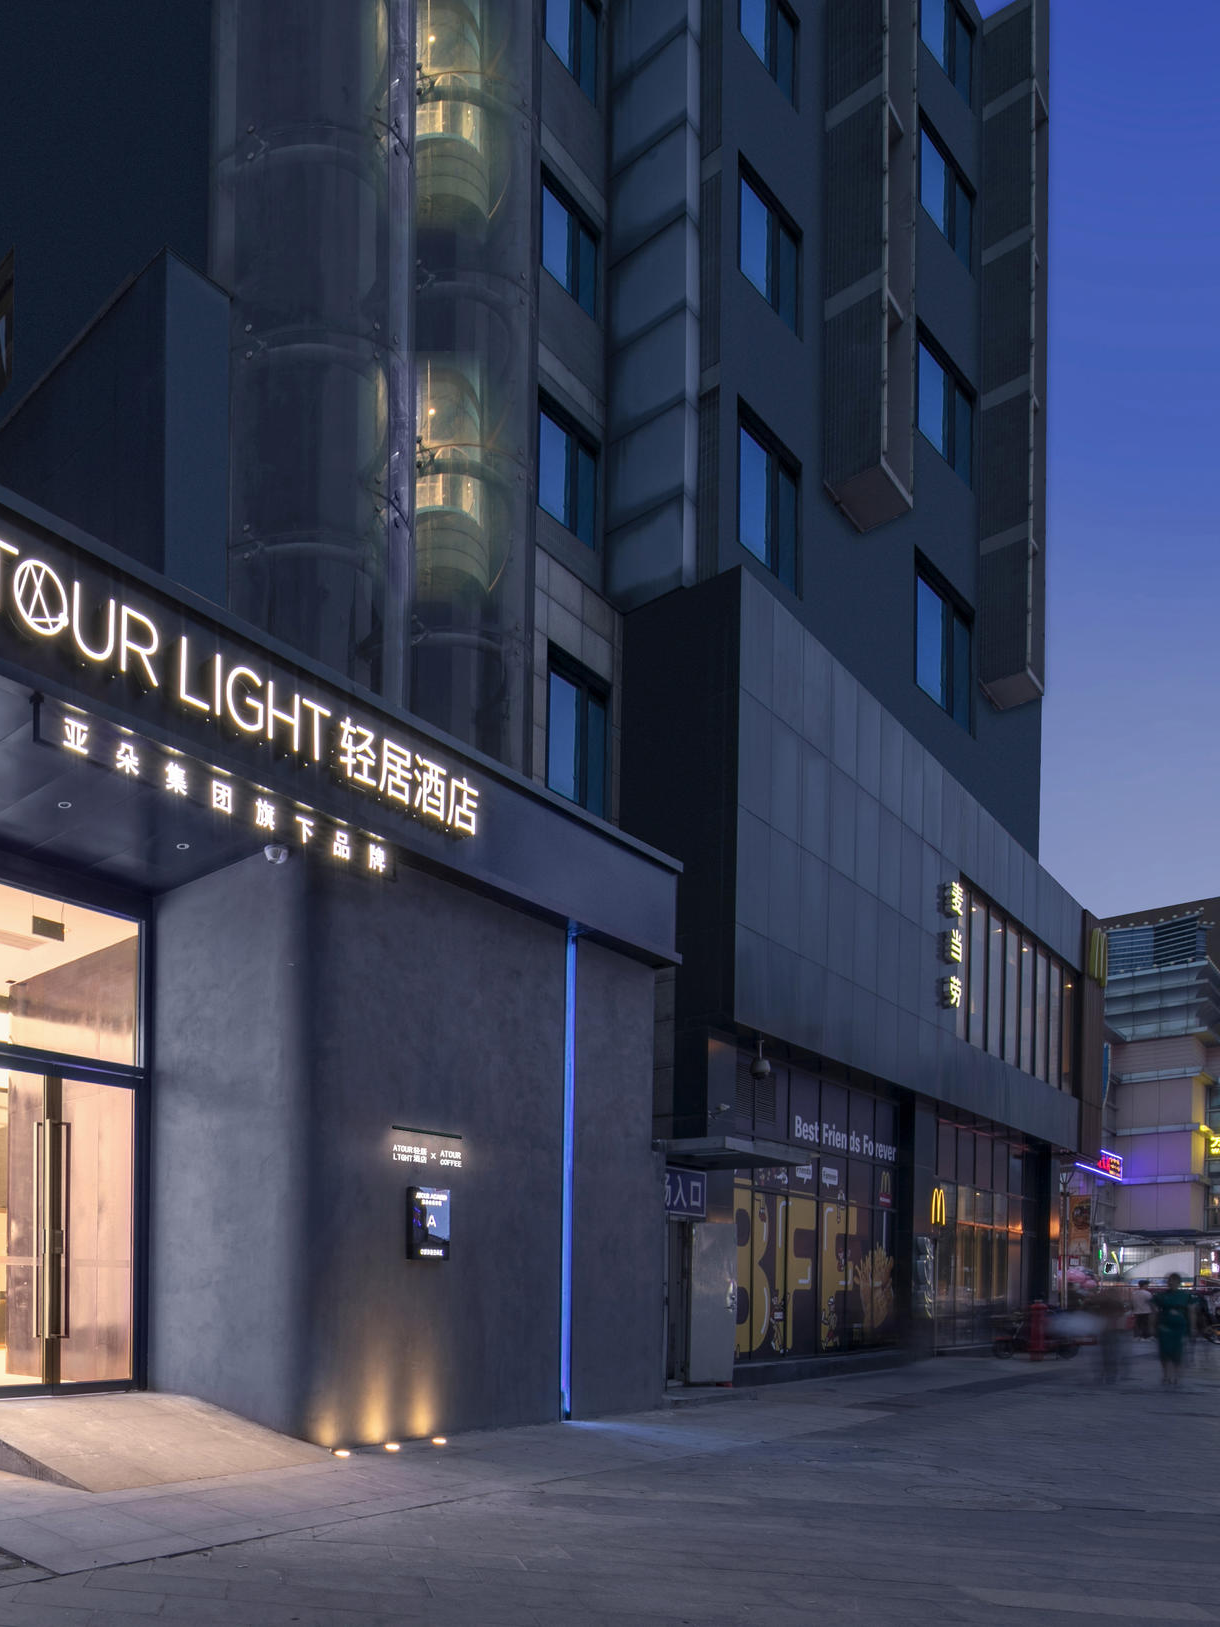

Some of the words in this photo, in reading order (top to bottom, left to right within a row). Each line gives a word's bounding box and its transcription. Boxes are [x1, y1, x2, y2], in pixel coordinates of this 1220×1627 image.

[179, 635, 331, 761] LIGHT
[339, 716, 479, 835] 轻居酒店
[63, 717, 386, 873] 亚朵集团旗下品牌
[794, 1115, 819, 1143] Best
[393, 1144, 413, 1154] ATOUR
[440, 1150, 462, 1160] ATOUR
[440, 1159, 463, 1168] COFFEE
